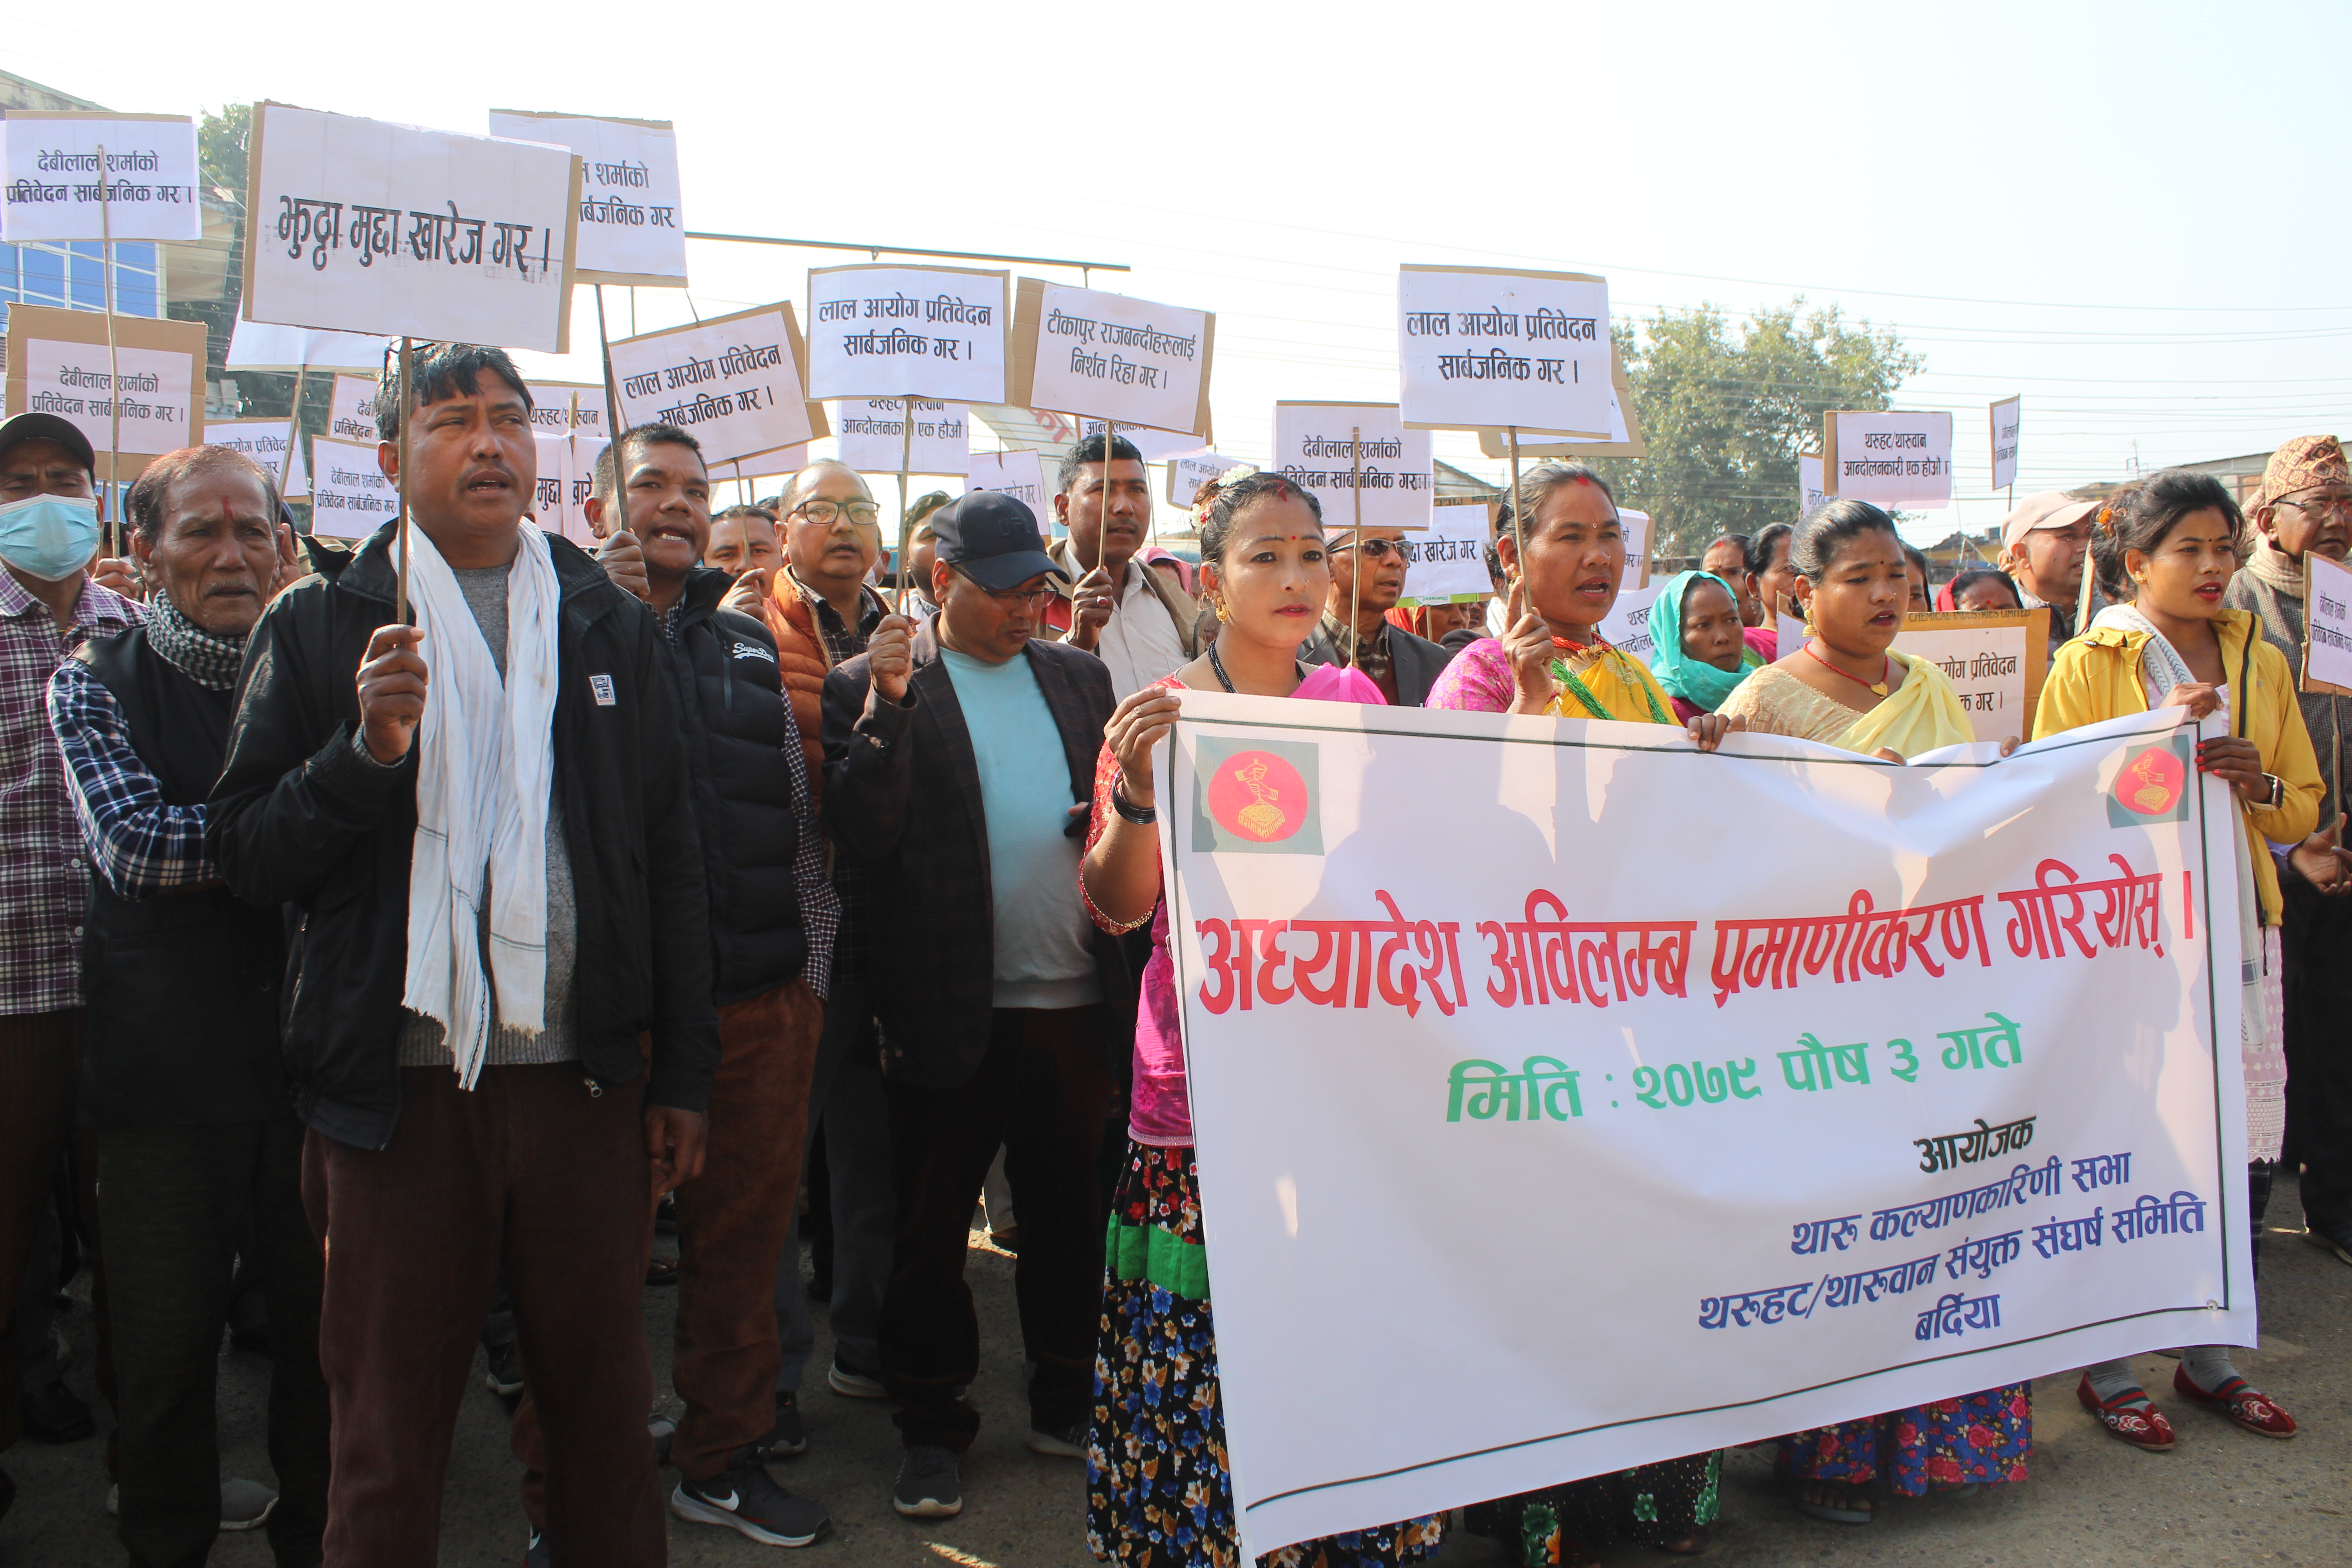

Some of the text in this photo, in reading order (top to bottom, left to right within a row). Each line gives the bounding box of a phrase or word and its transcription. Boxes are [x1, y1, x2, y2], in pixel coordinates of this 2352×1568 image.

[38, 150, 159, 173] देबीलाल शर्माको
[595, 160, 650, 189] शर्माको
[6, 179, 69, 205] प्रतिवेदन
[649, 206, 676, 228] गर
[408, 200, 486, 265] खारेज
[491, 221, 533, 273] गर
[818, 292, 993, 327] लाल आयोग प्रतिवेदन
[1406, 305, 1597, 343] लाल आयोग प्रतिवेदन
[1047, 308, 1098, 345] टीकापुर
[843, 327, 929, 357] सार्बजनिक
[933, 338, 960, 361] गर
[59, 365, 160, 394] देबीलाल शर्माको
[622, 344, 782, 400] लाल आयोग प्रतिवेदन
[1110, 354, 1137, 385] रिहा
[1139, 365, 1159, 390] गर
[1437, 348, 1531, 381] सार्बजनिक
[1537, 358, 1565, 385] गर
[32, 391, 85, 415] प्रतिवेदन
[88, 397, 152, 420] सार्बनिक
[155, 405, 175, 422] गर
[735, 388, 762, 412] गर
[918, 421, 935, 437] एक
[255, 436, 289, 454] प्रतिवेद
[1303, 435, 1402, 459] देबीलाल शर्माको
[331, 466, 360, 487] देबीलाल
[1180, 459, 1197, 472] लाल
[1198, 464, 1221, 477] आयोग
[1844, 456, 1904, 477] आन्दोलनकारी
[1906, 461, 1920, 475] एक
[317, 490, 346, 510] प्रतिवेदन
[1424, 534, 1457, 563] खारेज
[1460, 540, 1477, 560] गर
[1909, 609, 2030, 622] CHEMICAL INDUSTRIES LIMITED
[1970, 652, 2017, 681] प्रतिवेदन
[1975, 691, 1994, 711] गर
[1196, 889, 1468, 1019] अध्यादेश
[1476, 888, 1698, 1008] अविलम्ब
[1711, 889, 1991, 1009] प्रमाणीकरण
[1446, 1055, 1583, 1123] मिति
[1632, 1056, 1762, 1110] २०७९
[1776, 1032, 1871, 1092] पौष
[1886, 1038, 1920, 1083] ३
[1936, 1012, 2022, 1070] गते
[1913, 1115, 2037, 1174] आयोजक
[1869, 1155, 2062, 1241] कल्याणकारिणी
[2071, 1152, 2132, 1193] सभा
[2032, 1206, 2104, 1259] संघर्ष
[2111, 1191, 2207, 1245] समिति
[1915, 1292, 2001, 1341] बर्दिया
